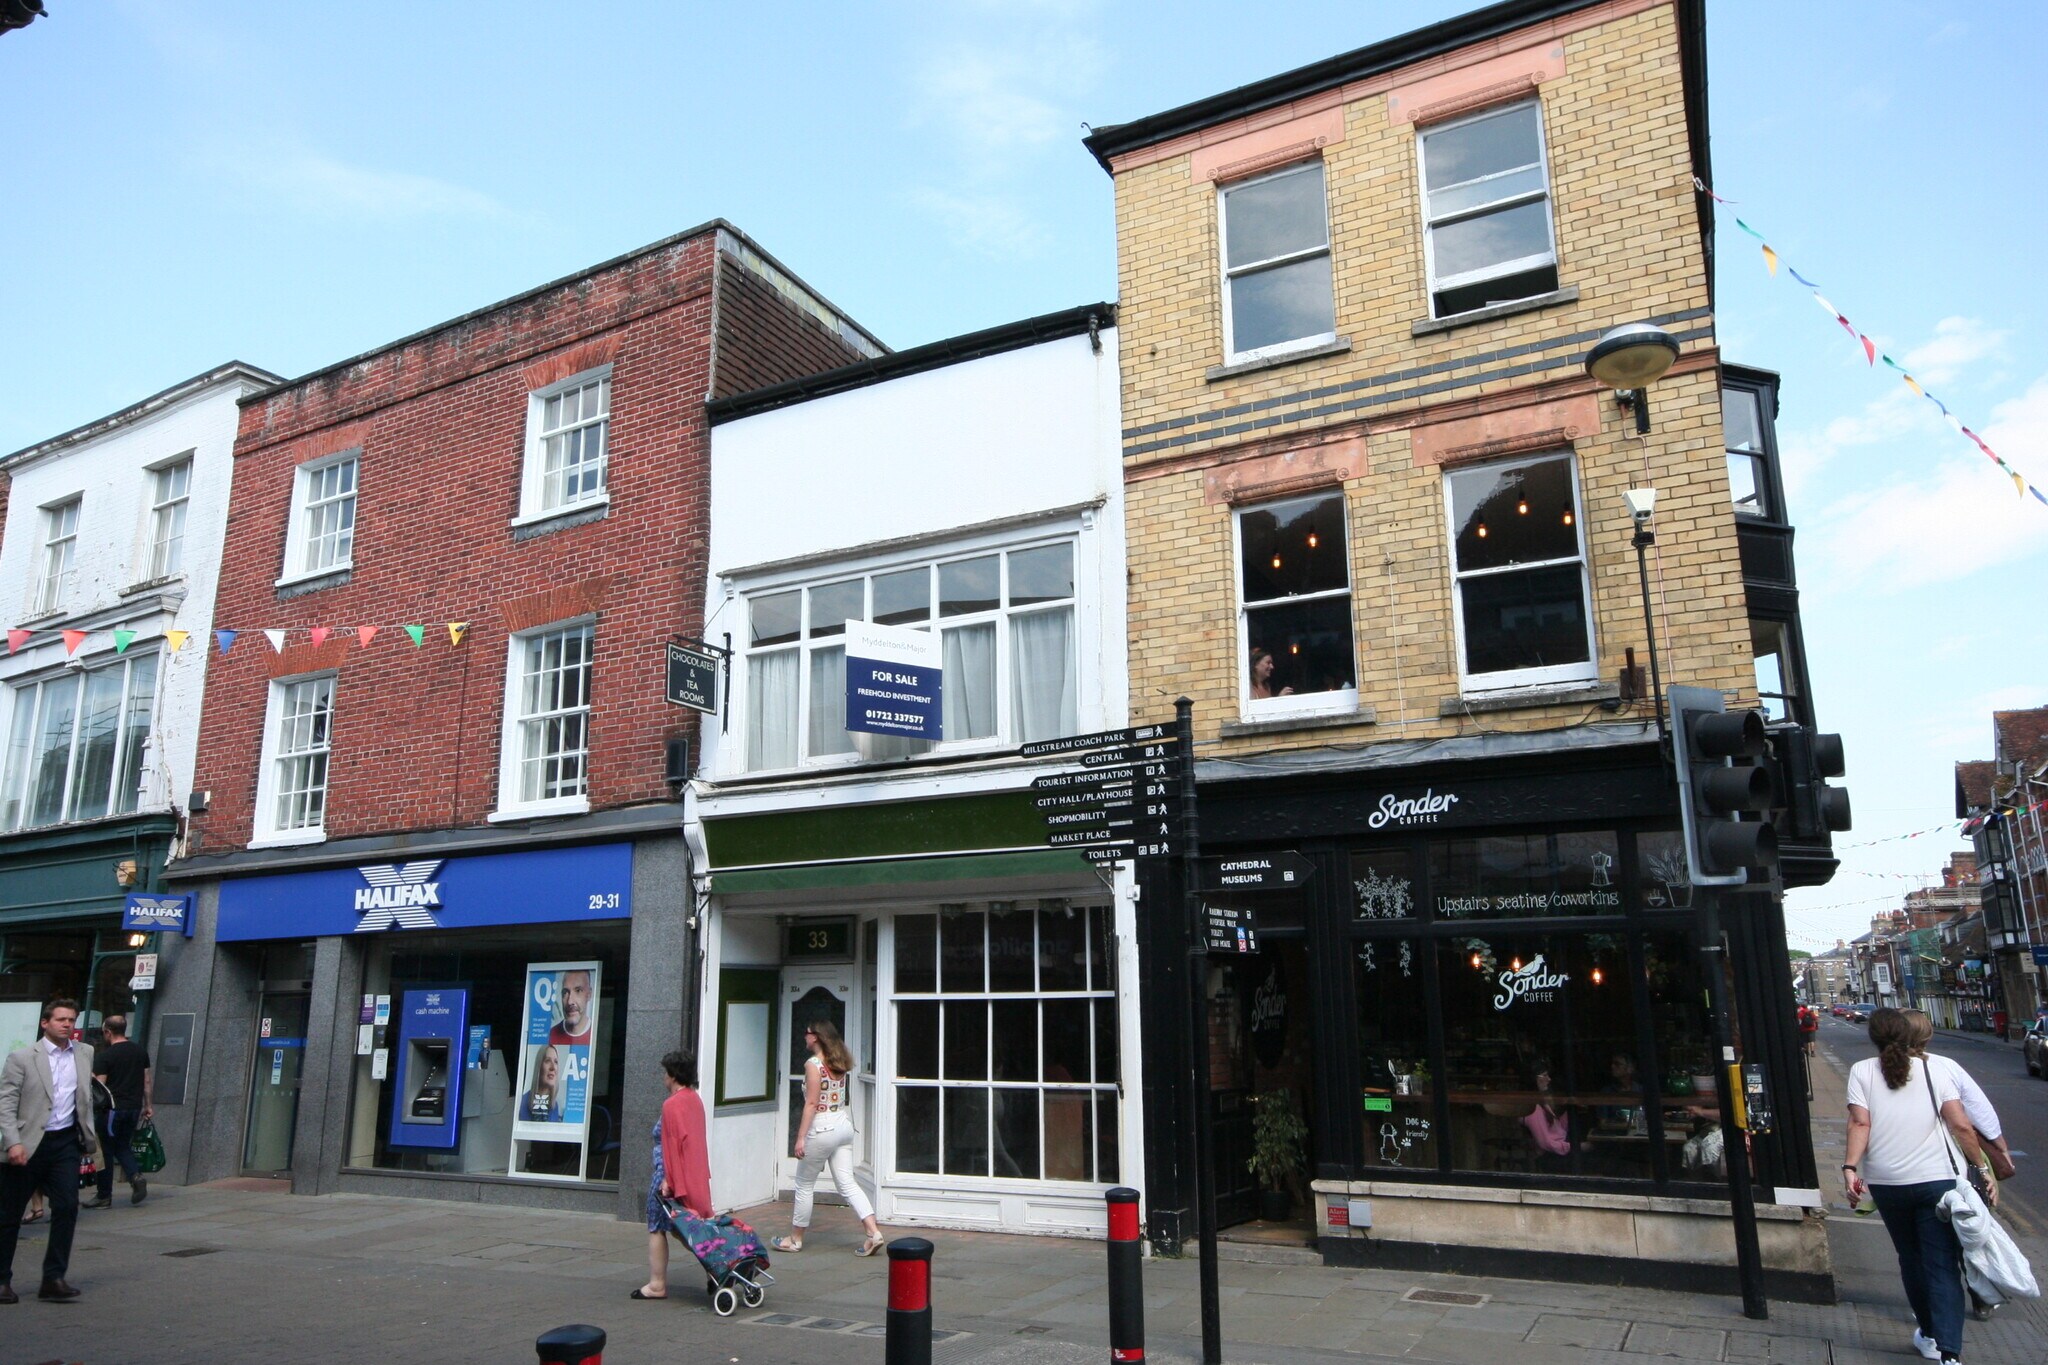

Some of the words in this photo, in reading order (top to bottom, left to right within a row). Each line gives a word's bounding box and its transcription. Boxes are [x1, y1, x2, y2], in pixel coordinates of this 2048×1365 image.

[861, 635, 927, 654] Myddelton&Major
[671, 650, 715, 672] CHOCOLATES
[689, 669, 696, 678] &
[872, 670, 892, 682] FOR
[895, 674, 918, 686] SALE
[686, 679, 699, 691] TEA
[679, 690, 705, 705] ROOMS
[857, 687, 891, 700] FREEHOLD
[892, 692, 931, 704] INVESTMENT
[866, 710, 892, 721] 01722
[894, 713, 924, 724] 337577
[1023, 739, 1073, 755] MILLSTREAM
[1074, 736, 1102, 749] COACH
[1104, 733, 1125, 745] PARK
[1085, 752, 1124, 765] CENTRAL
[1037, 776, 1072, 788] TOURIST
[1074, 769, 1133, 784] INFORMATION
[1037, 796, 1057, 807] CITY
[1368, 787, 1459, 829] Sonder
[1048, 810, 1107, 824] SHOPMOBILITY
[1399, 814, 1438, 825] COFFEE
[1050, 831, 1084, 843] MARKET
[1086, 829, 1111, 841] PLACE
[1087, 848, 1122, 860] TOILETS
[1220, 859, 1271, 871] CATHEDRAL
[1221, 873, 1263, 885] MUSEUMS
[355, 882, 440, 910] HALIFAX
[588, 892, 620, 911] 29-31
[130, 907, 183, 918] HALIFAX
[1437, 894, 1490, 917] Upstairs
[808, 931, 828, 949] 33
[533, 977, 558, 1012] Q:
[1494, 968, 1570, 1011] Sonder
[1524, 991, 1554, 1003] COFFEE
[415, 1007, 428, 1015] cash
[428, 1006, 450, 1015] machine
[561, 1053, 588, 1081] A:
